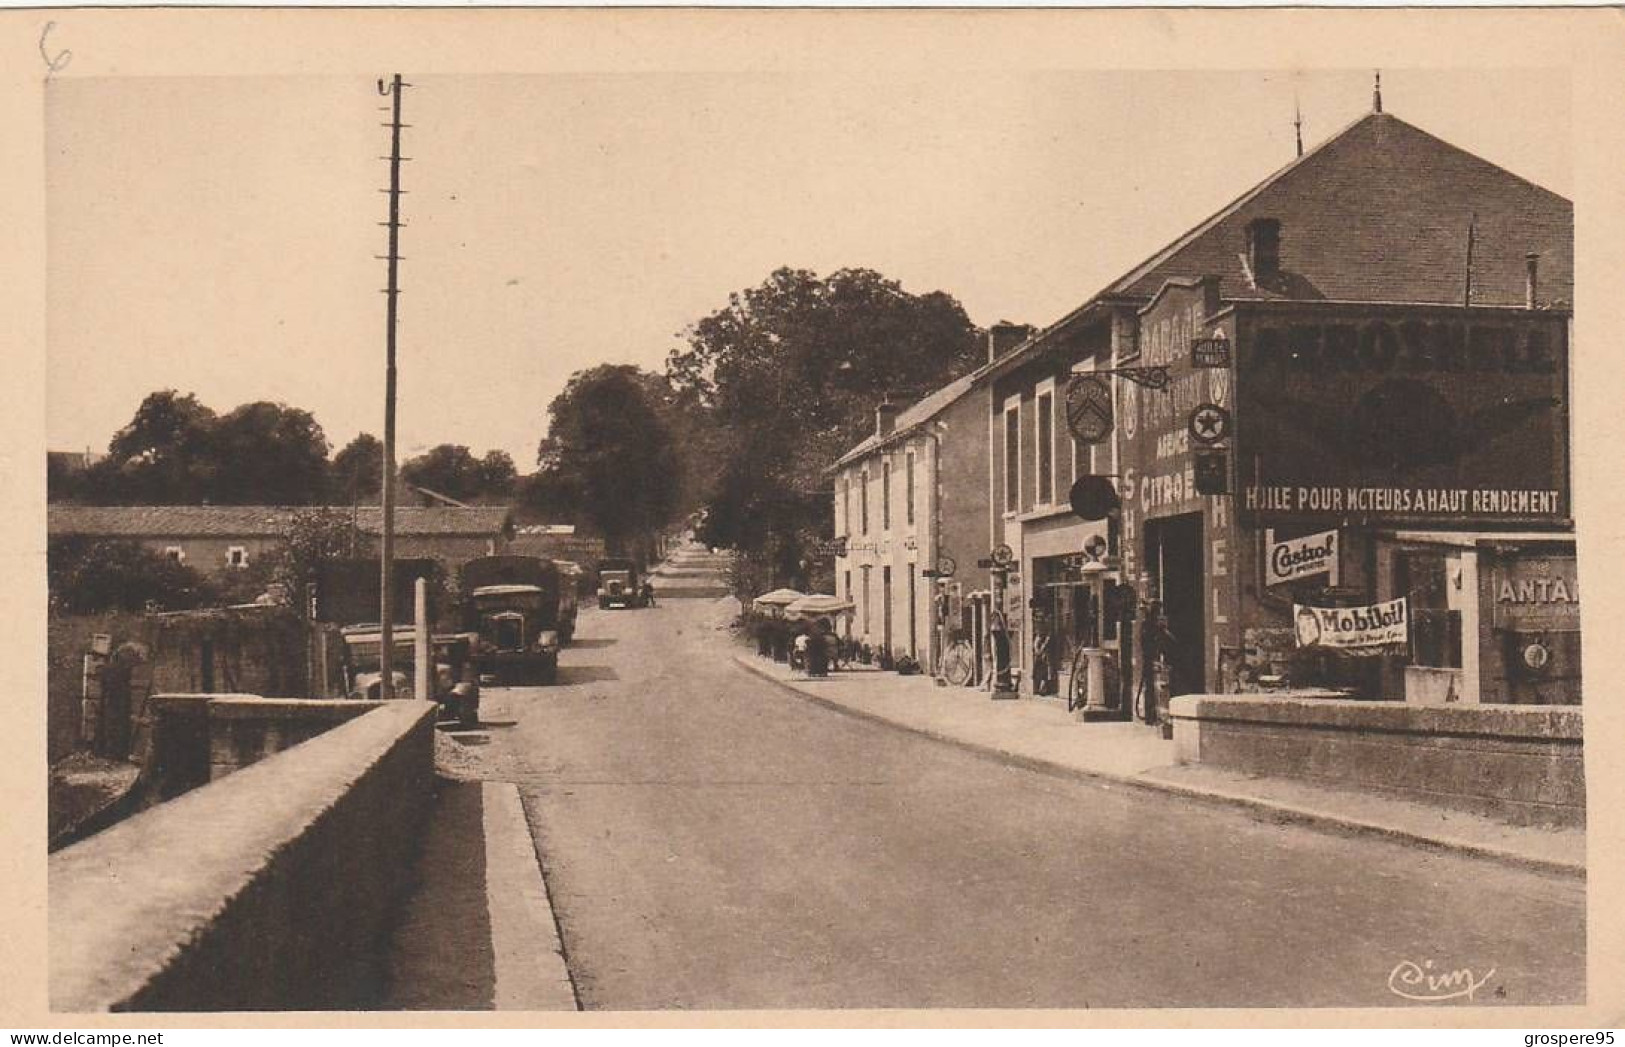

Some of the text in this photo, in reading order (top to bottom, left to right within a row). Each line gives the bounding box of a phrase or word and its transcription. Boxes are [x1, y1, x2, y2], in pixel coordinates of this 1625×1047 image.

[1246, 486, 1291, 510] HUILE
[1298, 487, 1343, 511] POUR
[1427, 489, 1467, 512] HAUT
[1472, 490, 1559, 514] RENDEMENT
[1273, 535, 1334, 578] Castrol
[1320, 601, 1404, 633] Mobiloil
